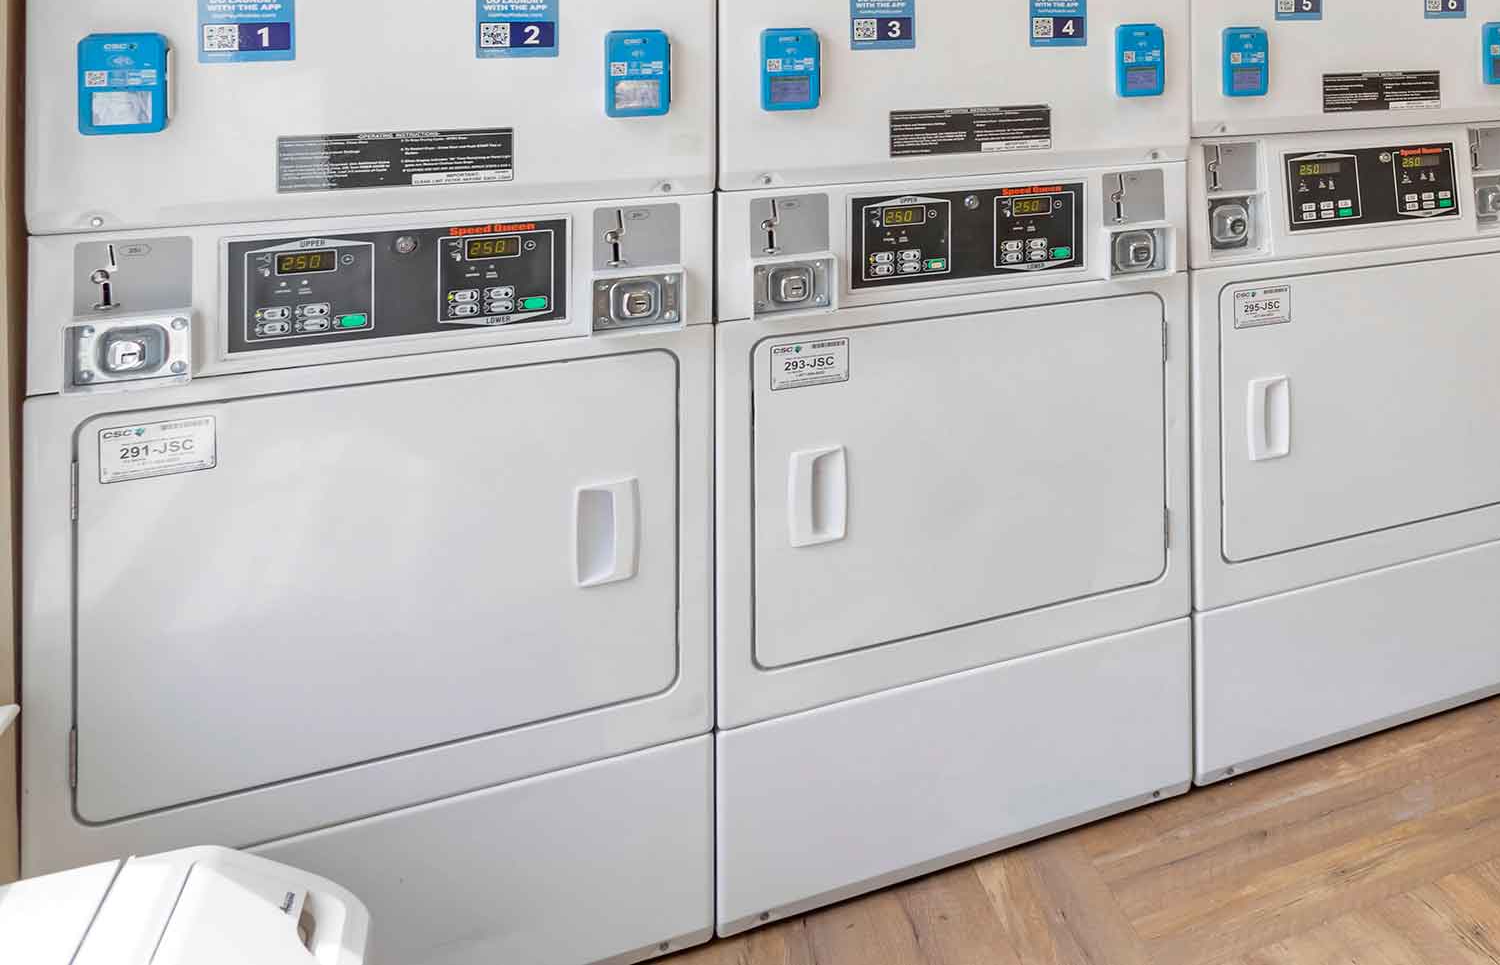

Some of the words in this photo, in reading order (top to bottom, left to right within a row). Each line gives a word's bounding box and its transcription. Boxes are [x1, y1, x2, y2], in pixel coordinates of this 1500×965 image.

[207, 4, 236, 12] WITH
[887, 21, 901, 38] 3
[1062, 19, 1075, 36] 4
[257, 27, 270, 47] 1
[523, 25, 540, 45] 2
[1299, 164, 1320, 175] 250
[1002, 188, 1032, 196] Speed
[1015, 200, 1040, 212] 250
[885, 210, 913, 224] 250
[448, 225, 492, 237] Speed
[494, 223, 537, 232] Queen
[300, 240, 326, 248] UPPER
[470, 240, 505, 255] 250
[281, 255, 321, 271] 250
[1244, 300, 1280, 313] 295-JSC
[486, 316, 511, 325] LOWER
[784, 356, 834, 371] 293-JSC
[119, 439, 194, 460] 291-JSC
